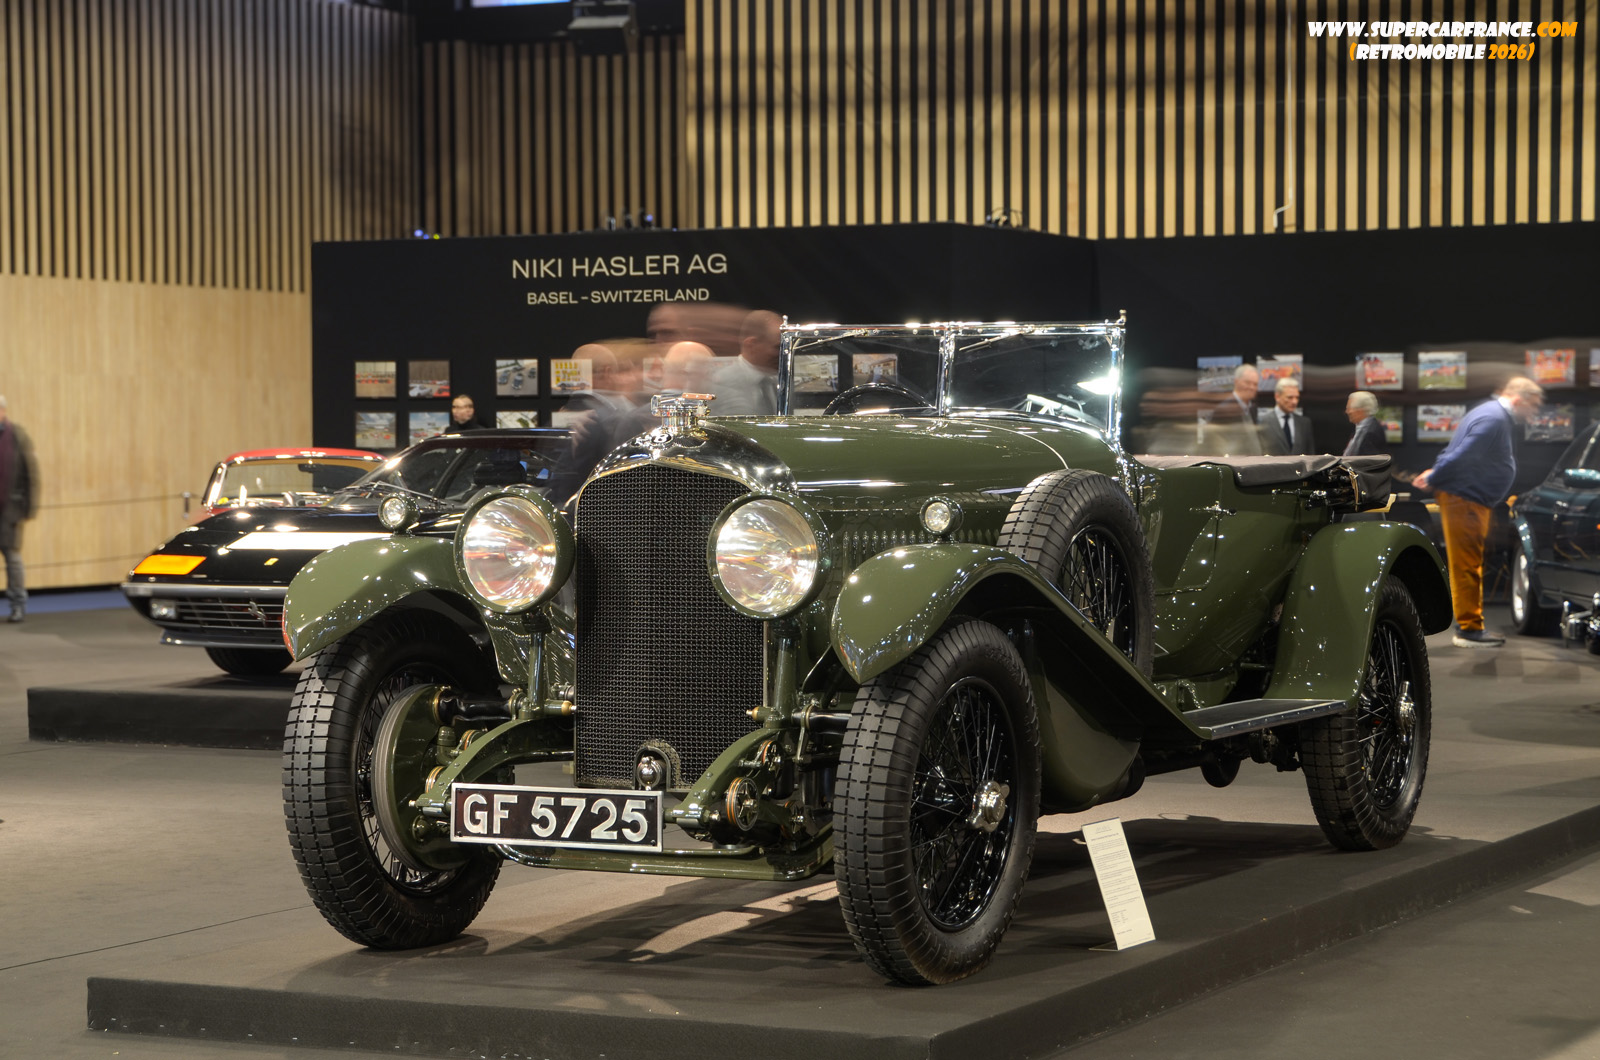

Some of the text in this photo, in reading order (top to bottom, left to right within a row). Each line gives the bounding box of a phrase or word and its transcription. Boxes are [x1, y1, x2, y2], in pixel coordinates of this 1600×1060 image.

[512, 253, 728, 279] NIKI HASLER AG
[463, 793, 648, 842] GF 5725
